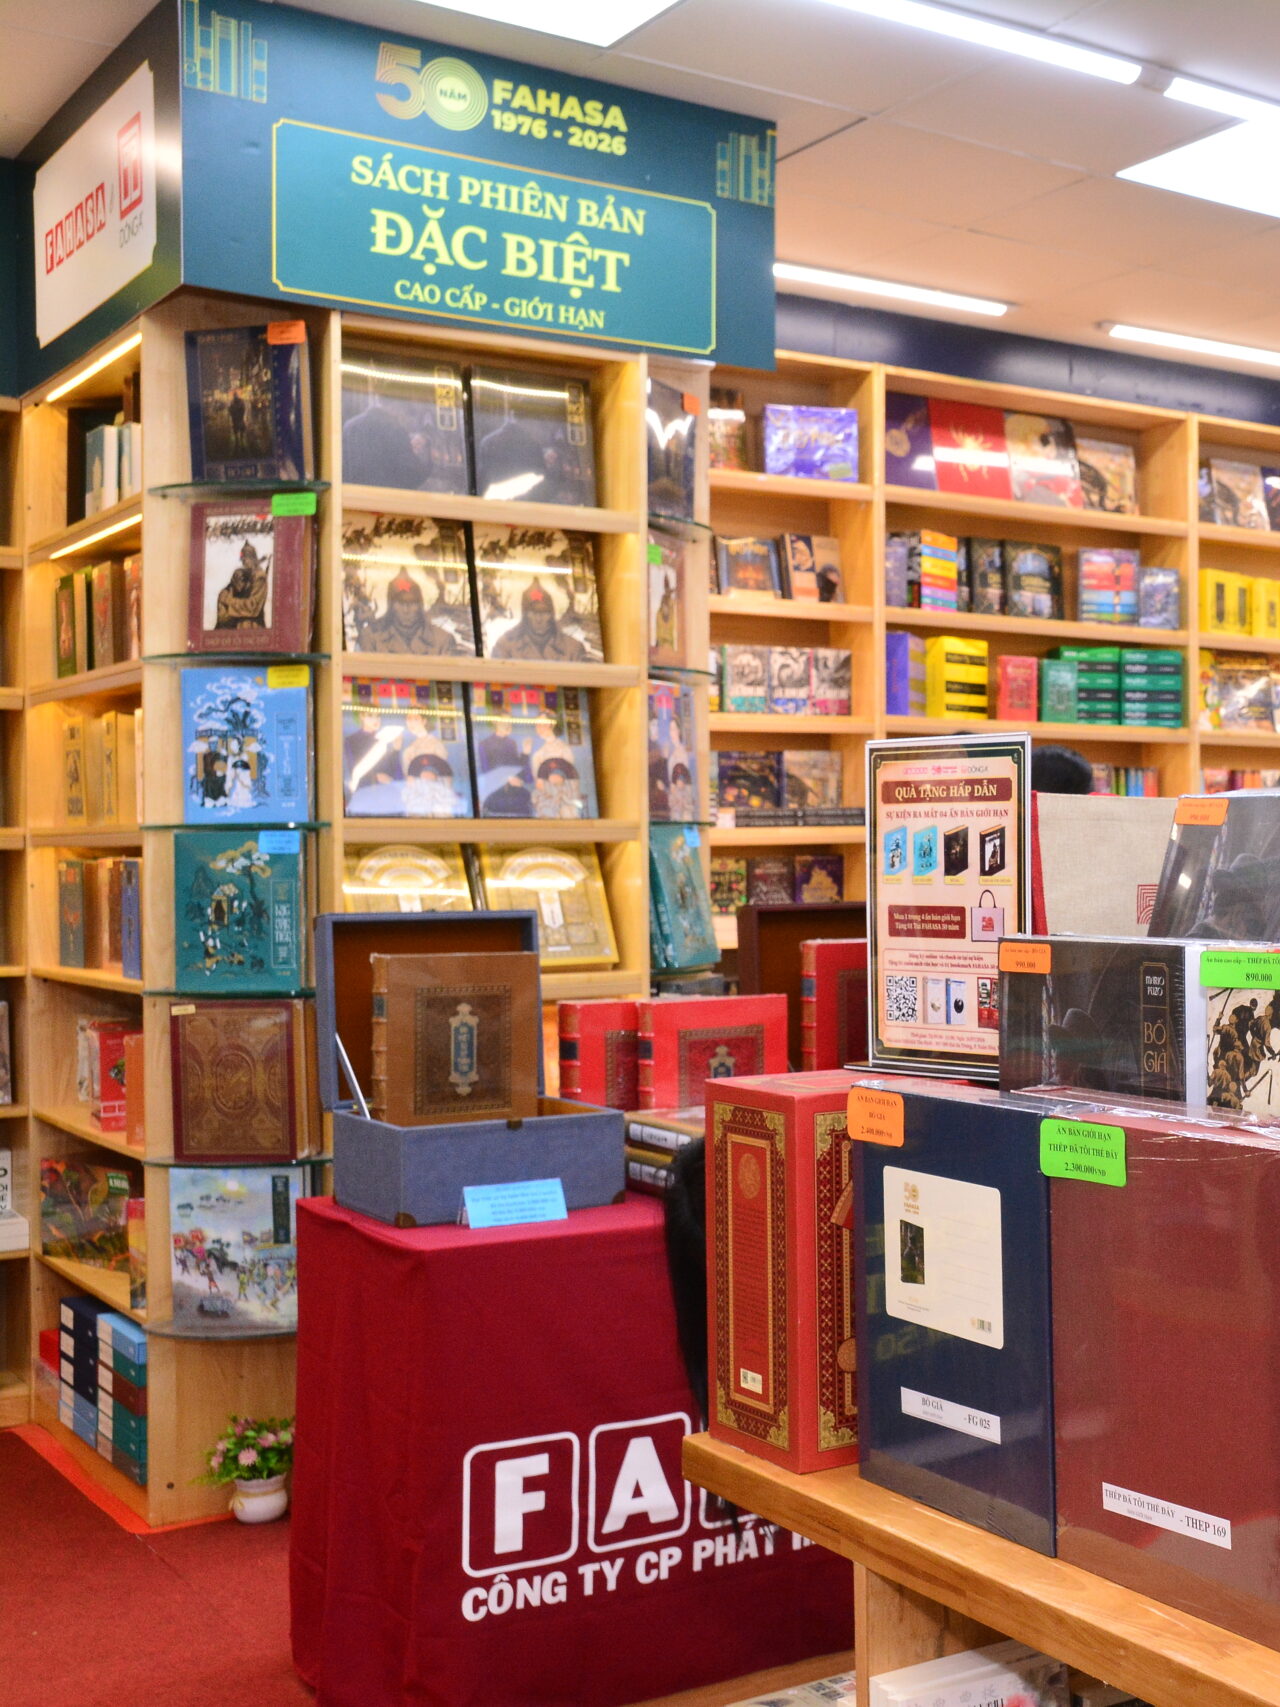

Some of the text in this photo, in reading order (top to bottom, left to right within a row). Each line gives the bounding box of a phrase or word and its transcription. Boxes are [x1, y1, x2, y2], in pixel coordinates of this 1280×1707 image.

[375, 42, 488, 131] 50
[492, 79, 627, 132] FAHASA
[491, 109, 548, 139] 1976
[567, 126, 626, 156] 2026
[351, 152, 645, 236] SÁCH PHIÊN BẢN
[45, 183, 106, 275] FAHASA
[370, 204, 630, 299] ĐẶC BIỆT
[394, 280, 605, 330] CAO CẤP GIỚI HẠN
[895, 779, 997, 800] QUÀ TẶNG HẤP DẪN
[1144, 1019, 1166, 1044] BỐ
[1144, 1048, 1167, 1073] GIÀ
[494, 1436, 690, 1555] FA
[1104, 1488, 1122, 1502] THÉP
[1185, 1515, 1226, 1538] THEP 169
[461, 1574, 568, 1622] CÔNG
[578, 1557, 624, 1596] TY
[635, 1546, 682, 1584] CP
[693, 1521, 780, 1572] PHÁT
